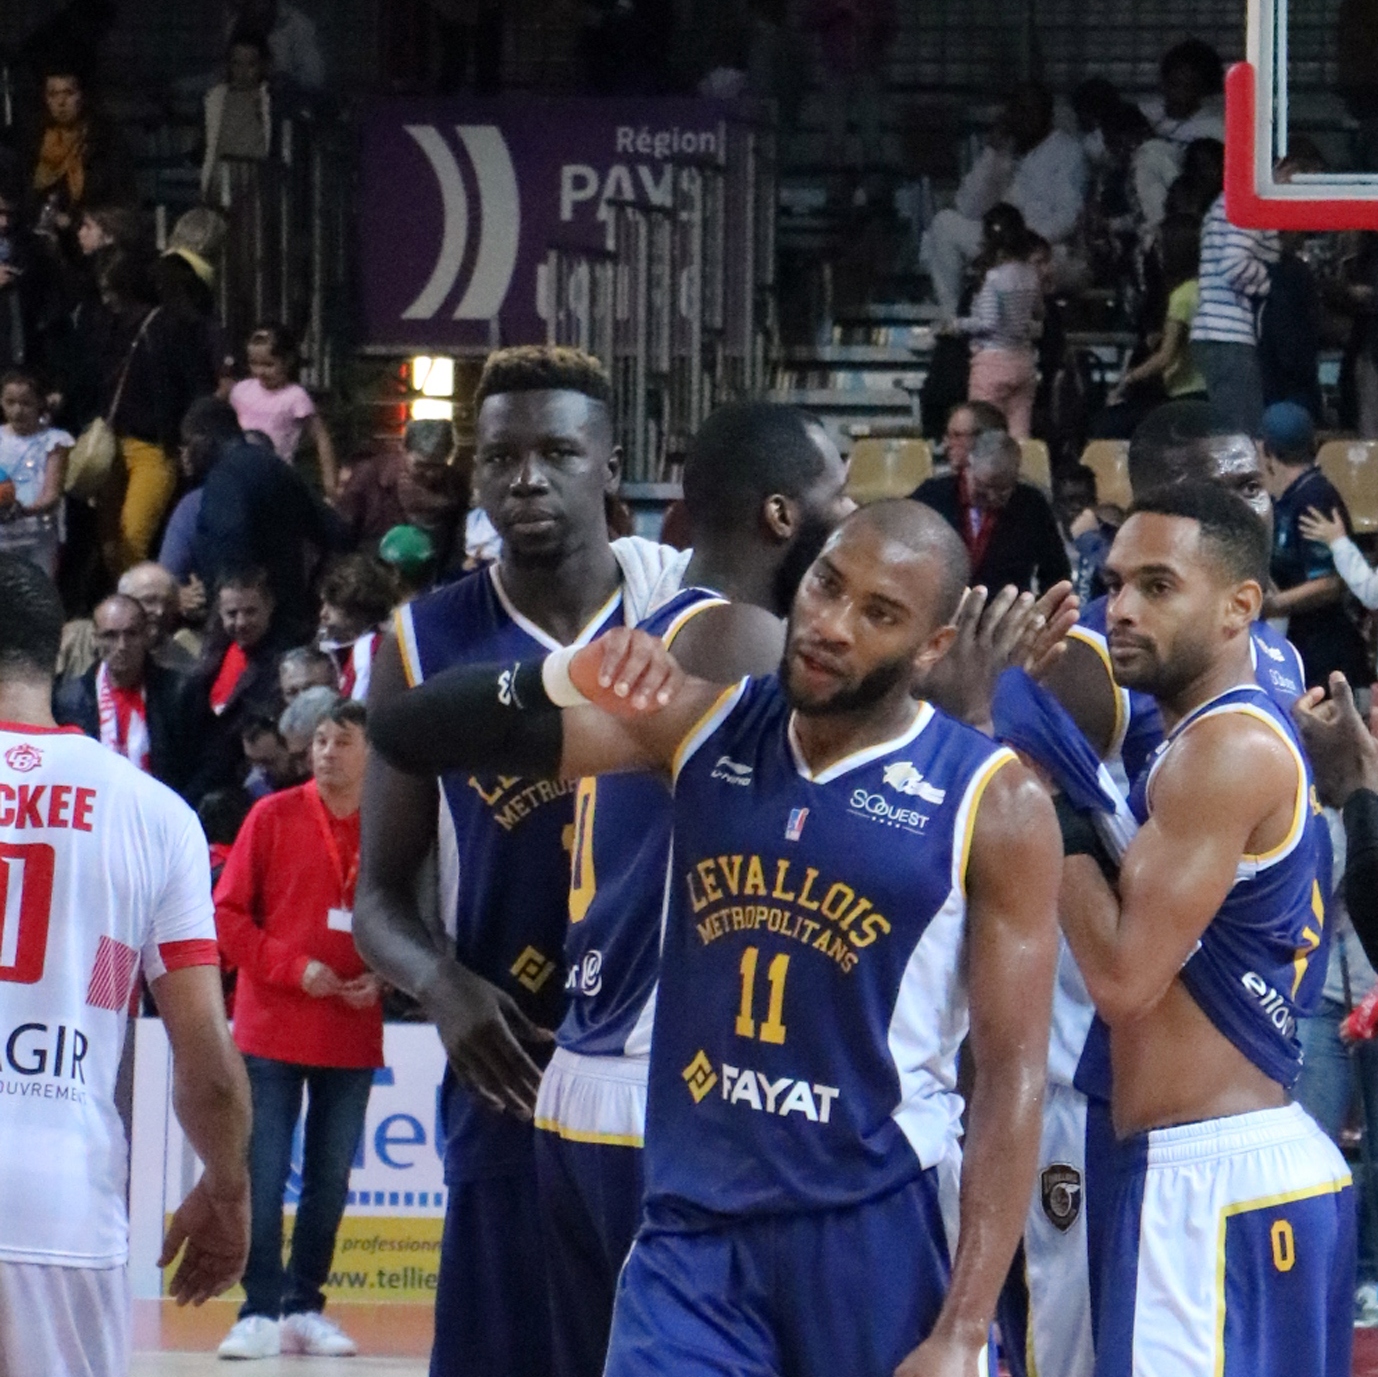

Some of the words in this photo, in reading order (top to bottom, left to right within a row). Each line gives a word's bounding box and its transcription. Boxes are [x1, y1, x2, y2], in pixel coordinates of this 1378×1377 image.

[617, 127, 716, 155] Région
[686, 855, 891, 948] LEVALLOIS
[697, 905, 859, 973] METROPOLITANS
[735, 946, 790, 1045] 11
[0, 1022, 88, 1085] GIR
[722, 1063, 839, 1122] FAYAT
[1271, 1219, 1295, 1272] 0
